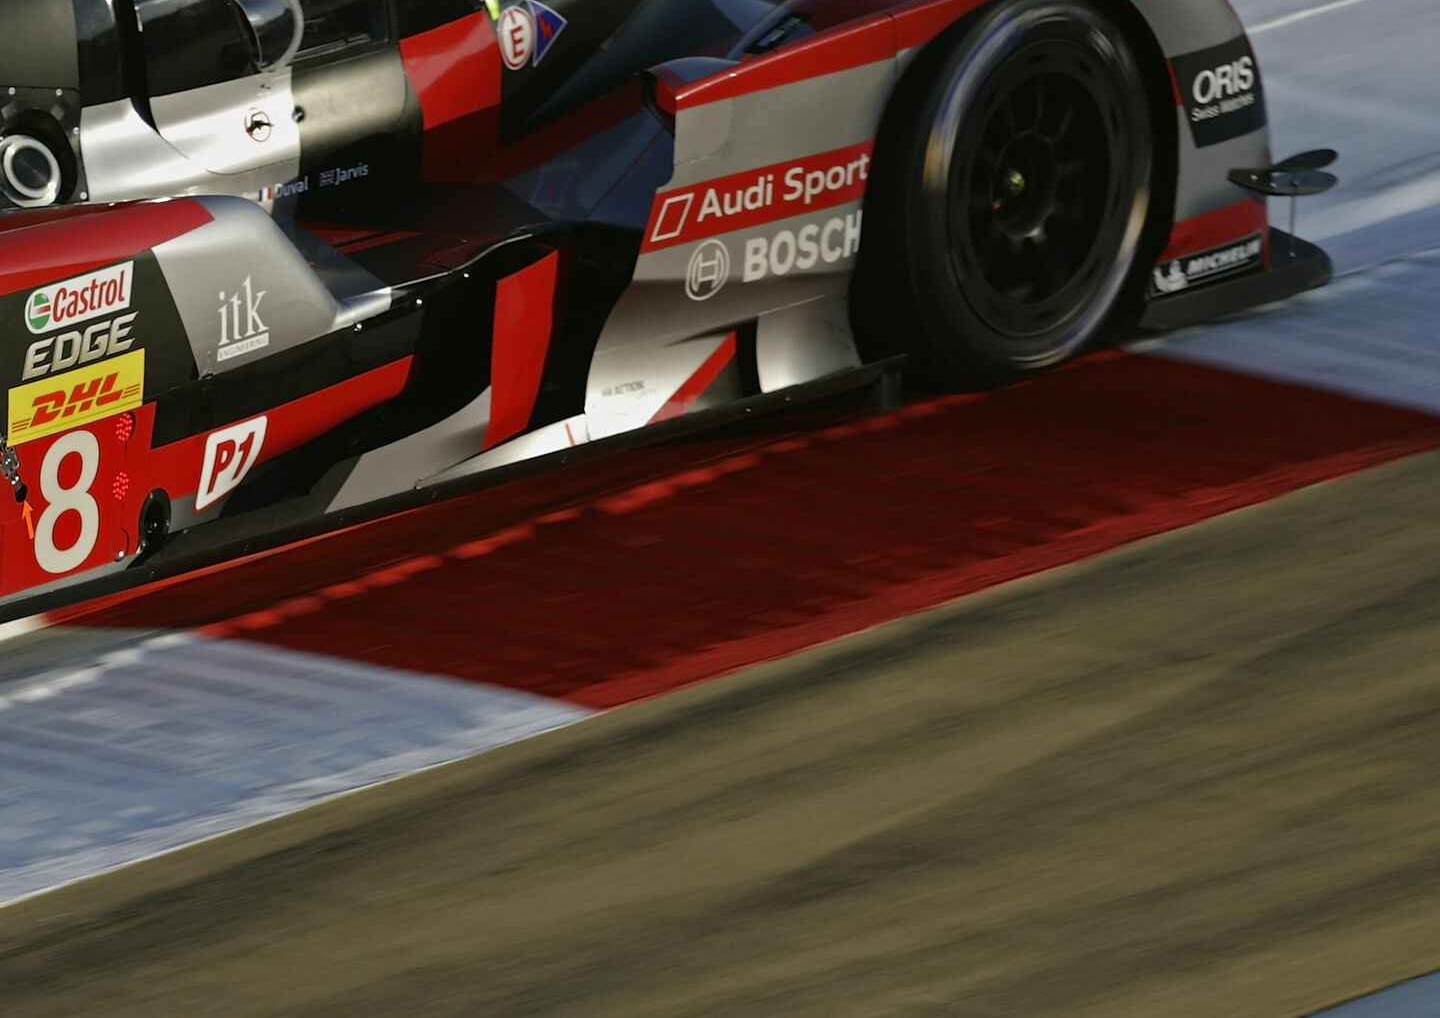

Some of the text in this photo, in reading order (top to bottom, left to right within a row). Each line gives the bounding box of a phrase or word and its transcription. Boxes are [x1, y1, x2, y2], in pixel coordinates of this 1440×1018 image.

[1192, 55, 1254, 104] ORIS
[274, 163, 369, 199] Duval Jarvis
[697, 153, 870, 223] Audi Sport
[743, 209, 863, 283] BOSCH
[53, 270, 125, 322] Castrol
[217, 273, 269, 346] itk
[22, 311, 139, 381] EDGE
[30, 372, 123, 427] DHL
[206, 431, 256, 495] P1
[34, 430, 100, 574] 8
